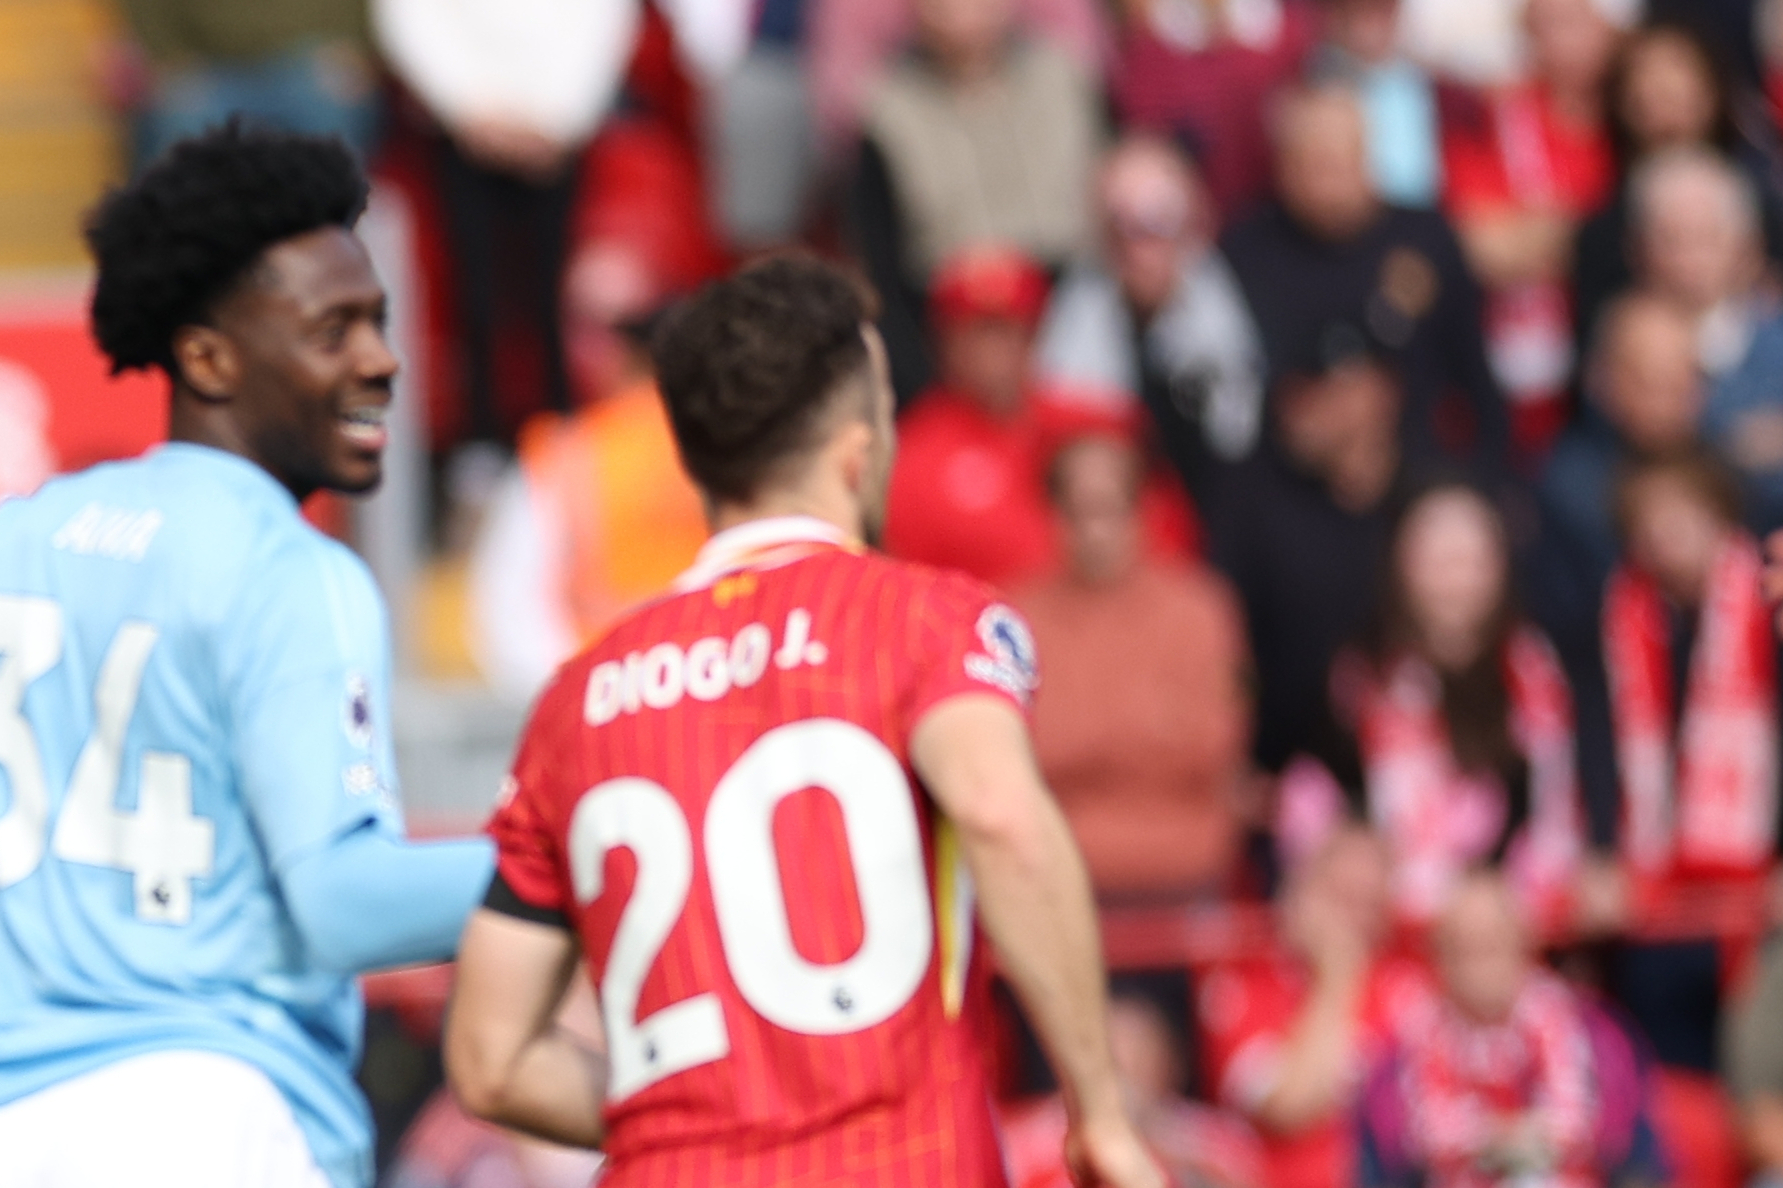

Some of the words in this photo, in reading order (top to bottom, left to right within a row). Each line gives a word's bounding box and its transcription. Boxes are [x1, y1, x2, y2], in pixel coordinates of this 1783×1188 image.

[583, 622, 771, 727] DIOGO
[774, 607, 828, 670] J.
[569, 717, 933, 1104] 20
